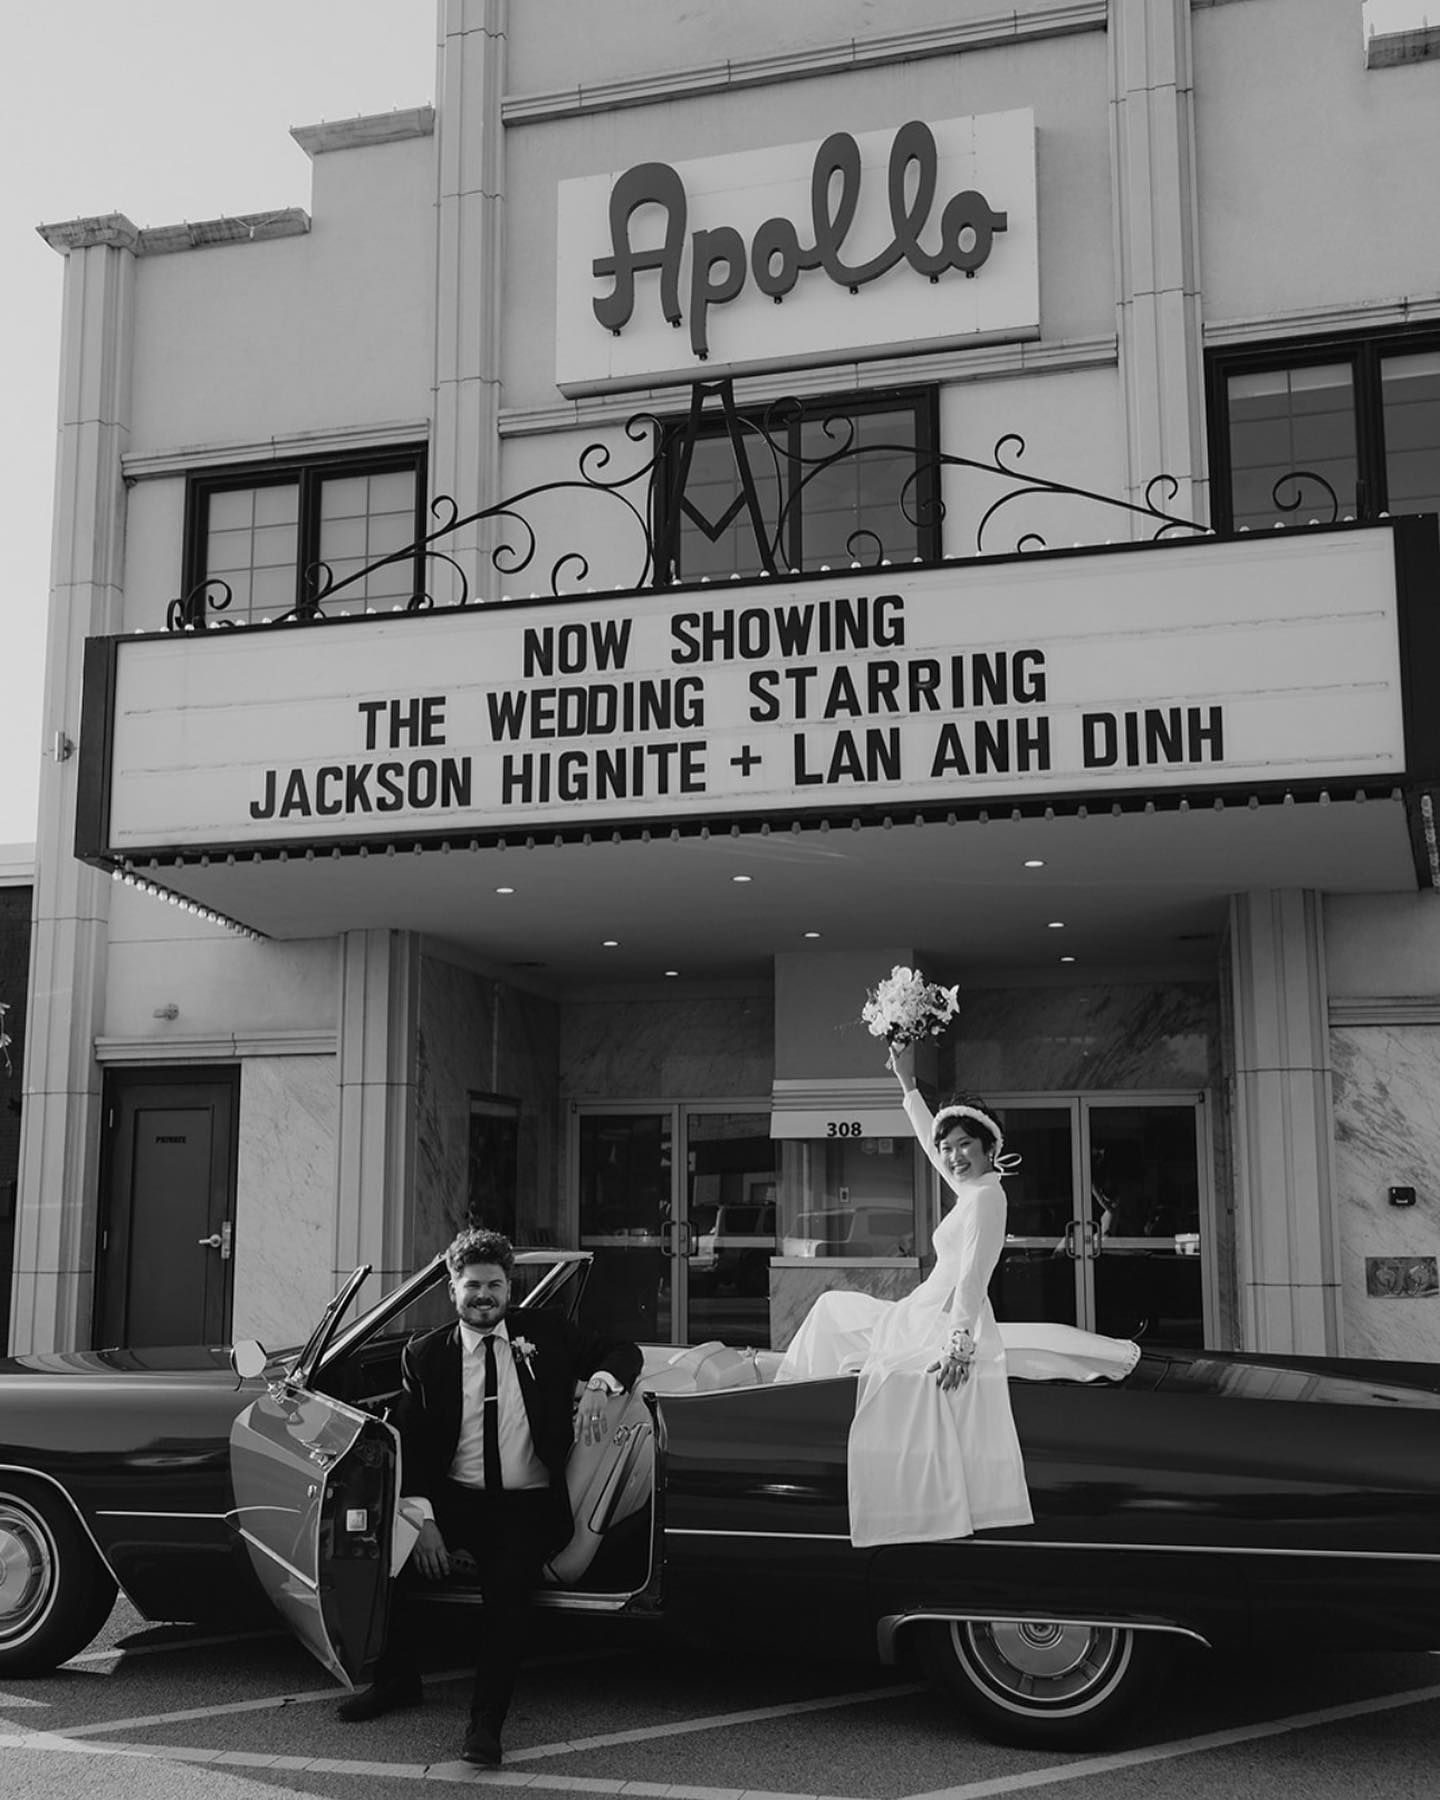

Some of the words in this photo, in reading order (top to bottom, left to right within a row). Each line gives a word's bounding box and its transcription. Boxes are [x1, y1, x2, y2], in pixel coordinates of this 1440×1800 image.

[593, 120, 1008, 357] Apollo
[523, 618, 633, 678] NOW
[671, 594, 905, 665] SHOWING
[358, 696, 447, 751] THE
[486, 676, 704, 742] WEDDING
[749, 649, 1047, 723] STARRING
[249, 756, 472, 820] JACKSON
[501, 740, 707, 805] HIGNITE
[730, 745, 762, 777] +
[794, 726, 902, 786] LAN
[930, 716, 1051, 778] ANH
[1082, 705, 1225, 769] DINH
[827, 1122, 863, 1137] 308
